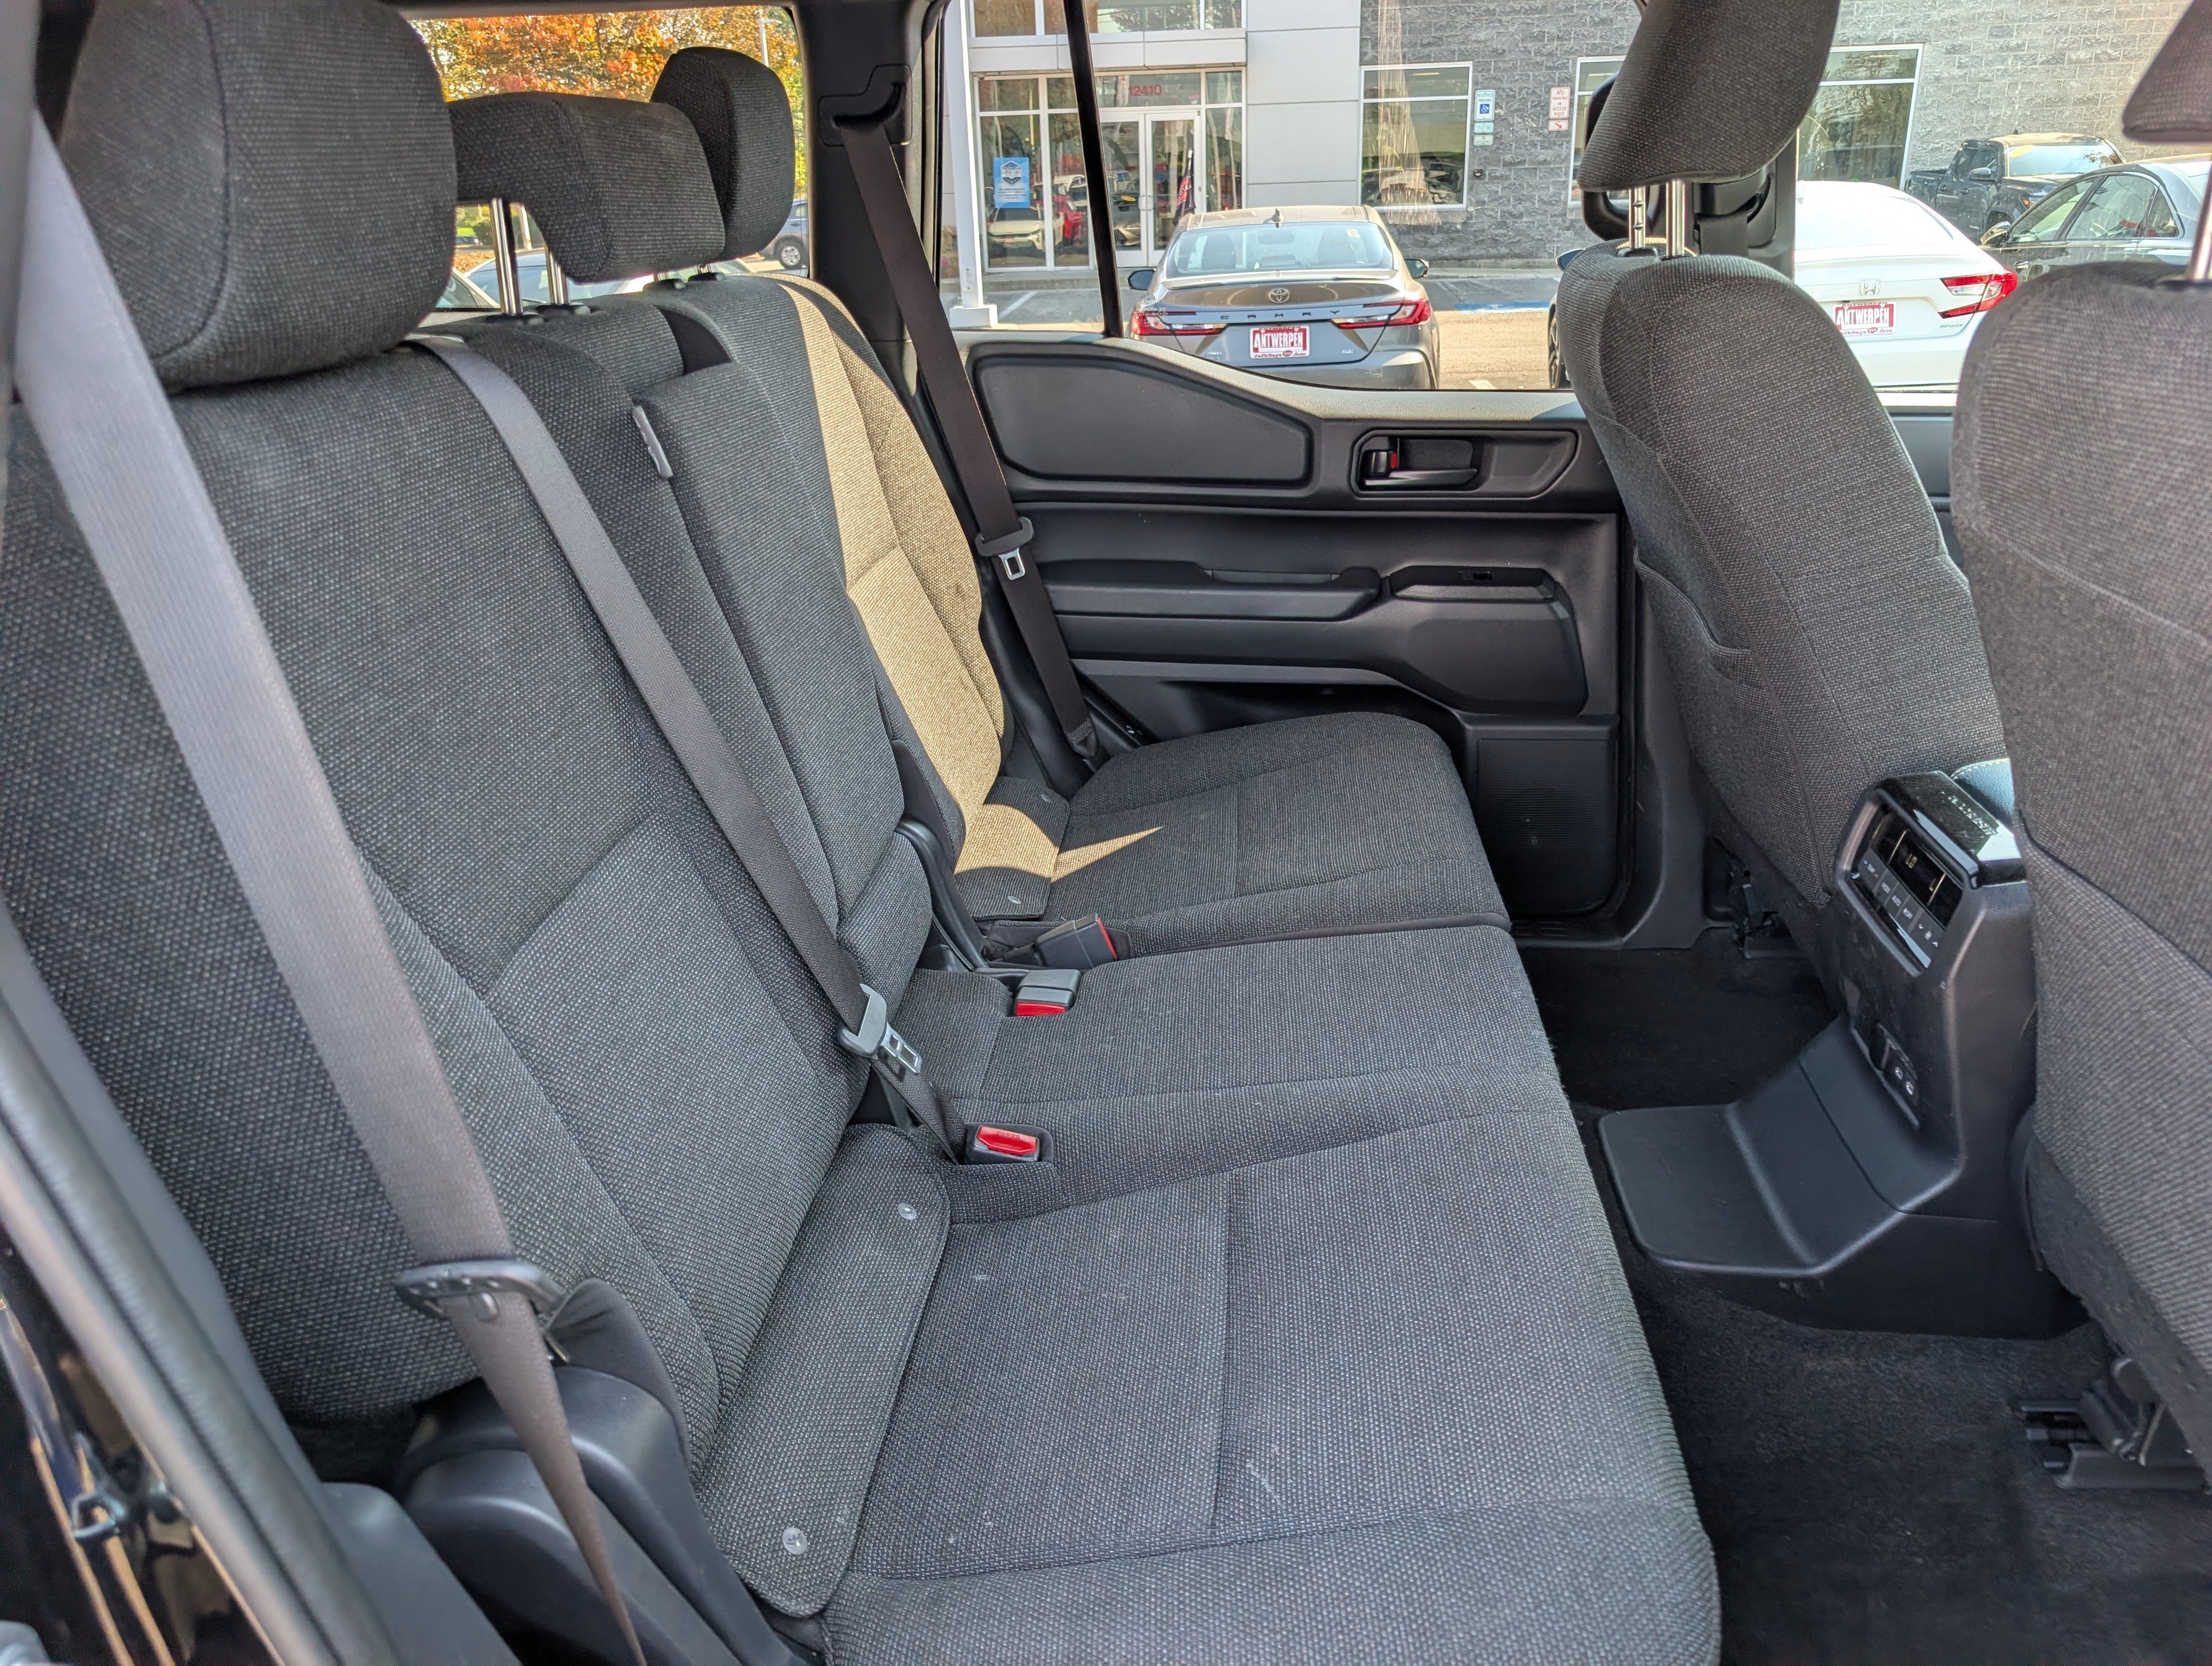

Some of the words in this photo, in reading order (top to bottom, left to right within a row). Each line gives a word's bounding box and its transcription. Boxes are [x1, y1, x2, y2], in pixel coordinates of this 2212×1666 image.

[1128, 84, 1163, 96] 12410
[1836, 307, 1890, 325] ANTWERPEN
[1253, 331, 1303, 348] ANTWERPEN
[996, 1130, 1020, 1140] PRESS
